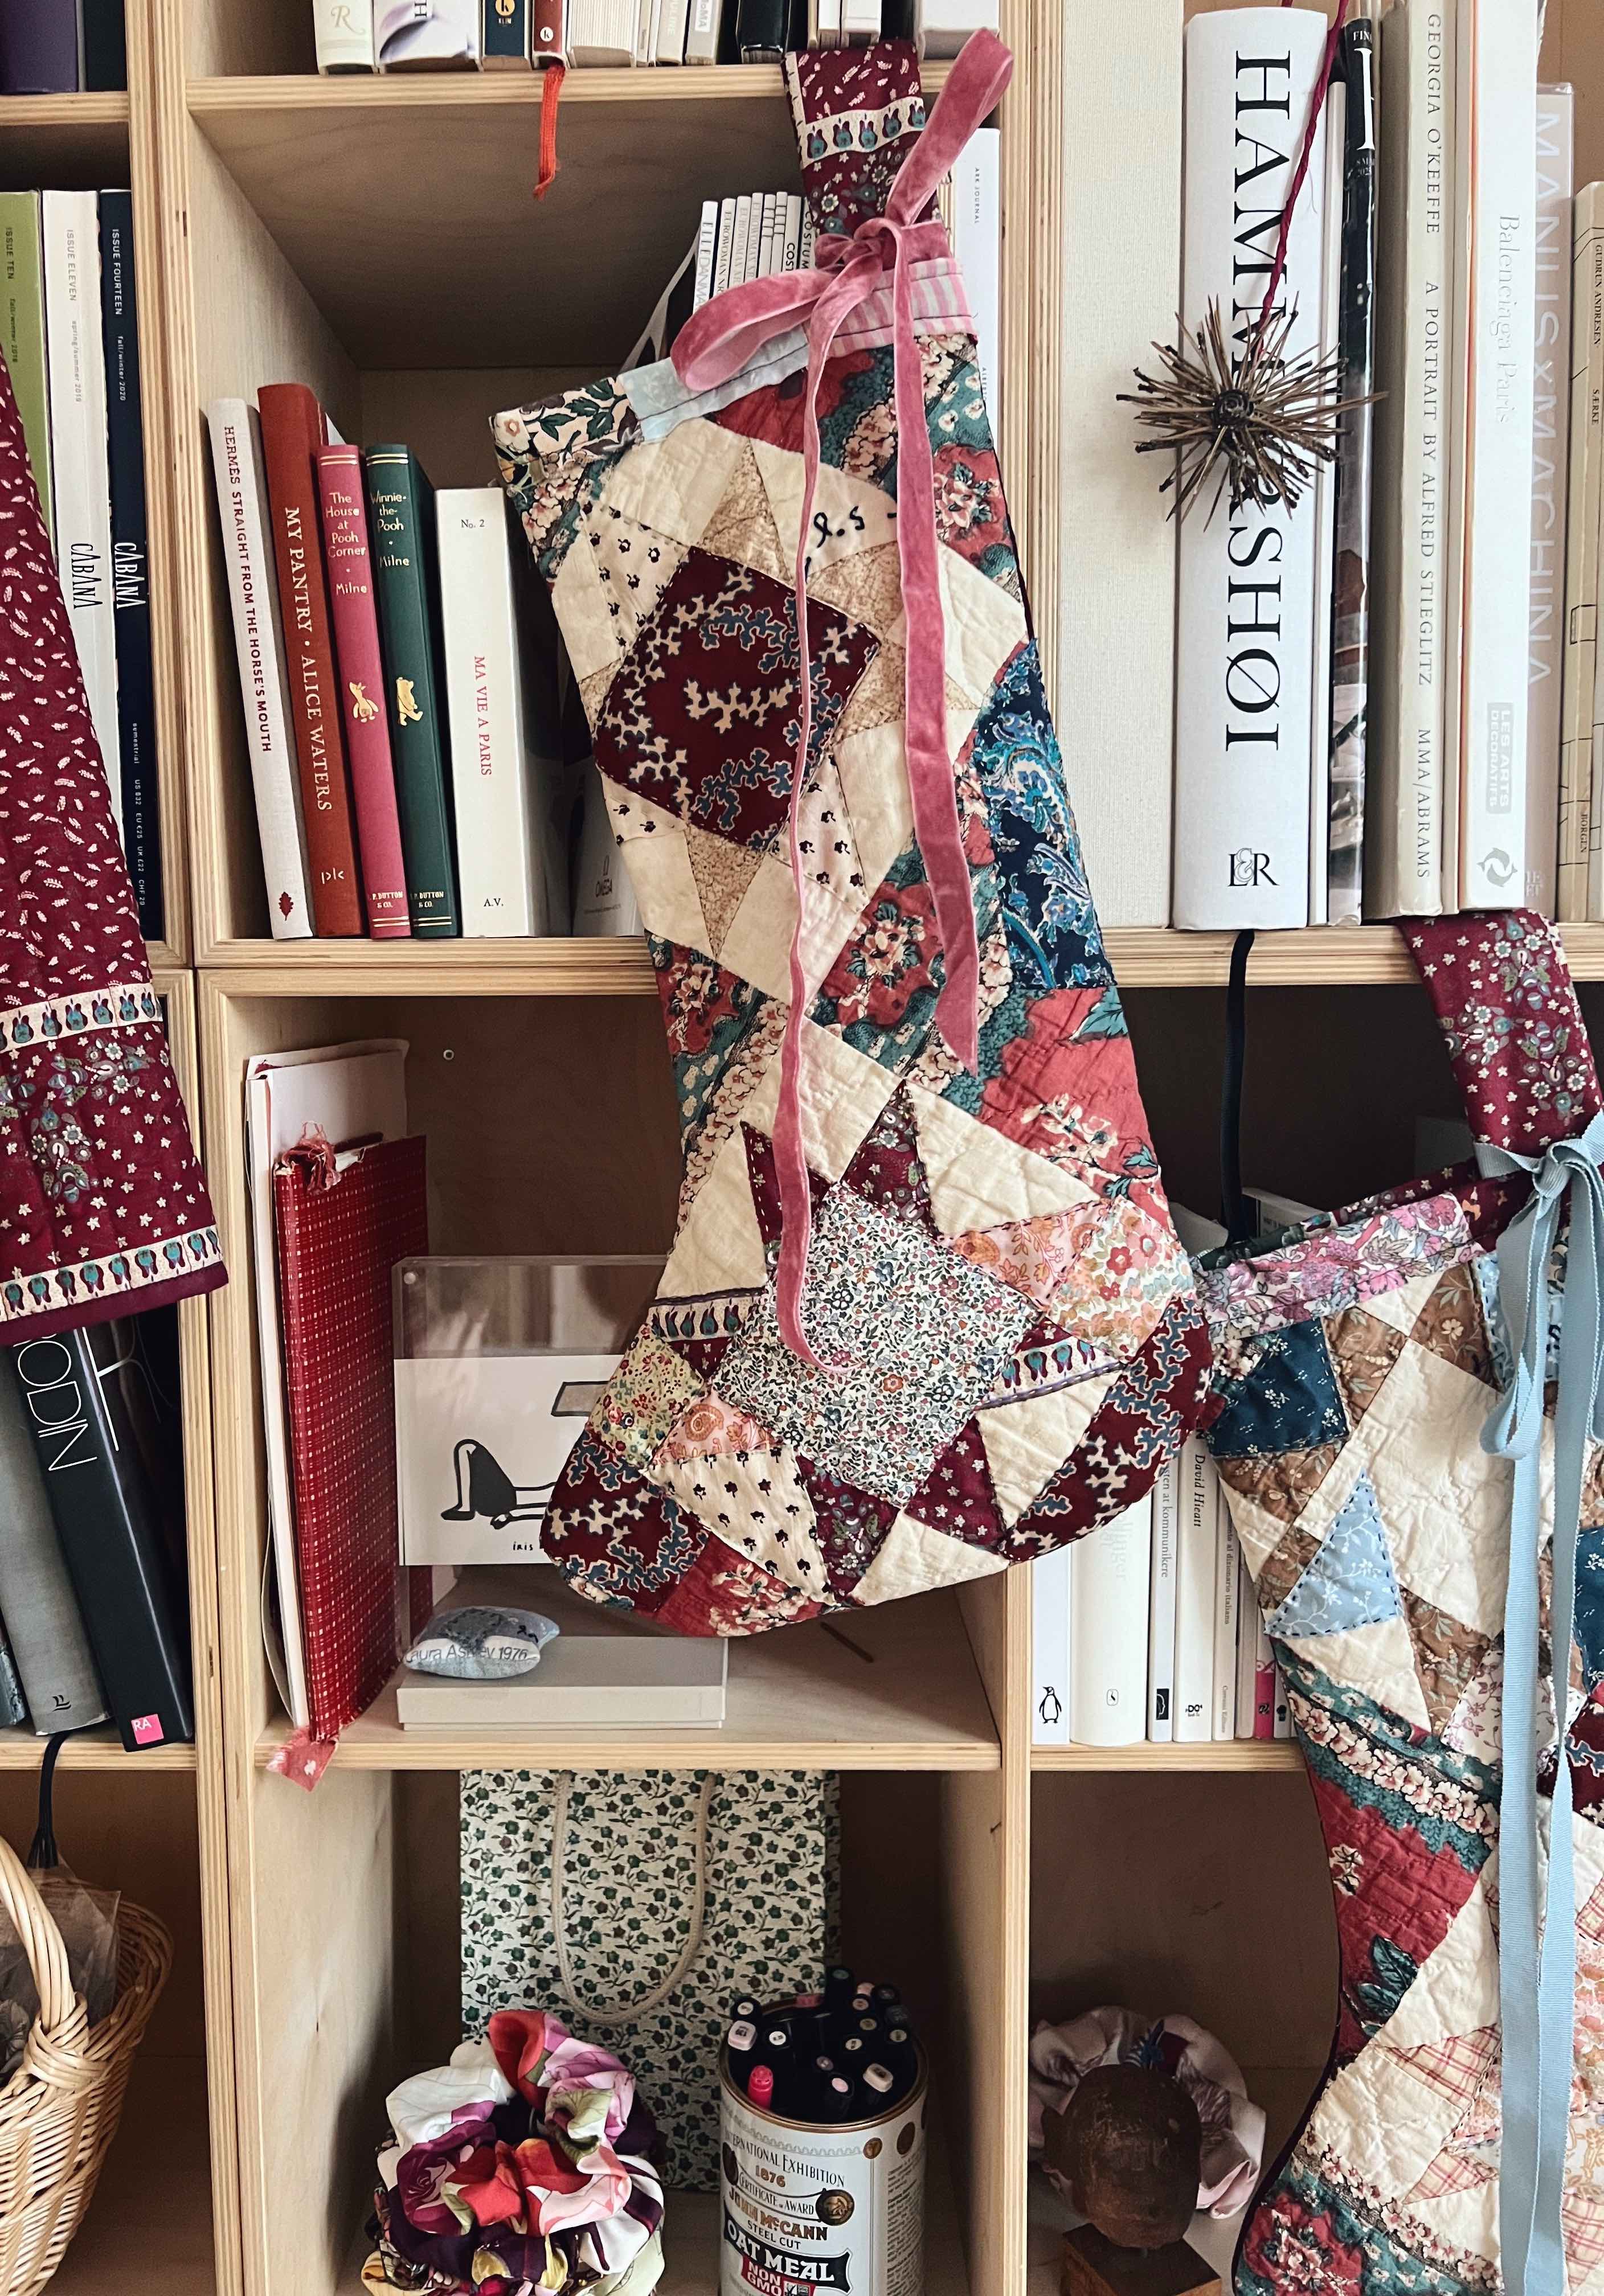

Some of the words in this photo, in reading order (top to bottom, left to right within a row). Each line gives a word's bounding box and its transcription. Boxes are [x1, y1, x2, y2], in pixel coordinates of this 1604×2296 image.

[1427, 14, 1441, 115] GEORGIA
[1426, 128, 1441, 234] O'KEEFFE
[67, 229, 75, 259] ISSUE
[700, 223, 713, 253] ELLE
[719, 212, 732, 274] EUROWOMAN
[68, 264, 77, 301] ELEVEN
[695, 257, 710, 306] DANMA
[1426, 281, 1439, 295] A
[1490, 215, 1520, 350] Balenciaga
[1424, 305, 1439, 421] PORTRAIT
[1496, 362, 1518, 424] Paris
[1423, 434, 1437, 461] BY
[326, 506, 360, 519] House
[329, 492, 352, 504] The
[232, 491, 249, 561] STRAIGHT
[285, 508, 302, 540] MY
[337, 520, 349, 530] at
[378, 518, 404, 534] Pooh
[461, 519, 476, 529] No.
[480, 519, 485, 527] 2
[1421, 473, 1437, 557] ALFRED
[328, 546, 366, 559] Corner
[332, 531, 359, 544] Pooh
[71, 543, 103, 610] CABANA
[114, 542, 146, 609] CABANA
[379, 555, 410, 568] Milne
[241, 565, 253, 604] FROM
[289, 547, 313, 633] PANTRY
[335, 582, 367, 596] Milne
[246, 608, 257, 634] THE
[1419, 569, 1435, 686] STIEGLITZ
[249, 639, 265, 697] HORSE'S
[474, 656, 486, 680] MA
[301, 654, 321, 720] ALICE
[476, 685, 488, 712] VIE
[257, 700, 272, 752] MOUTH
[478, 717, 488, 728] A
[1500, 710, 1511, 747] LES
[309, 725, 332, 812] WATERS
[479, 734, 492, 777] PARIS
[1499, 753, 1510, 807] ARTS
[136, 813, 142, 823] EU
[1417, 729, 1432, 878] MMA/ABRAMS
[378, 891, 403, 900] DUTTON
[483, 897, 504, 908] A.V.
[1194, 1454, 1206, 1486] David
[1163, 1493, 1170, 1502] at
[1193, 1490, 1205, 1527] Hieatt
[1161, 1507, 1173, 1577] kommunikere
[133, 1719, 152, 1732] RA
[756, 2165, 785, 2187] 1876
[783, 2154, 845, 2187] EXHIBITION
[739, 2172, 777, 2205] CERTIFICATE
[785, 2200, 814, 2215] AWARD
[727, 2219, 760, 2261] OAT
[765, 2249, 835, 2281] MEAL
[748, 2220, 776, 2242] STEEL
[780, 2237, 801, 2249] CUT
[747, 2272, 782, 2296] GMO
[748, 2262, 781, 2286] NON
